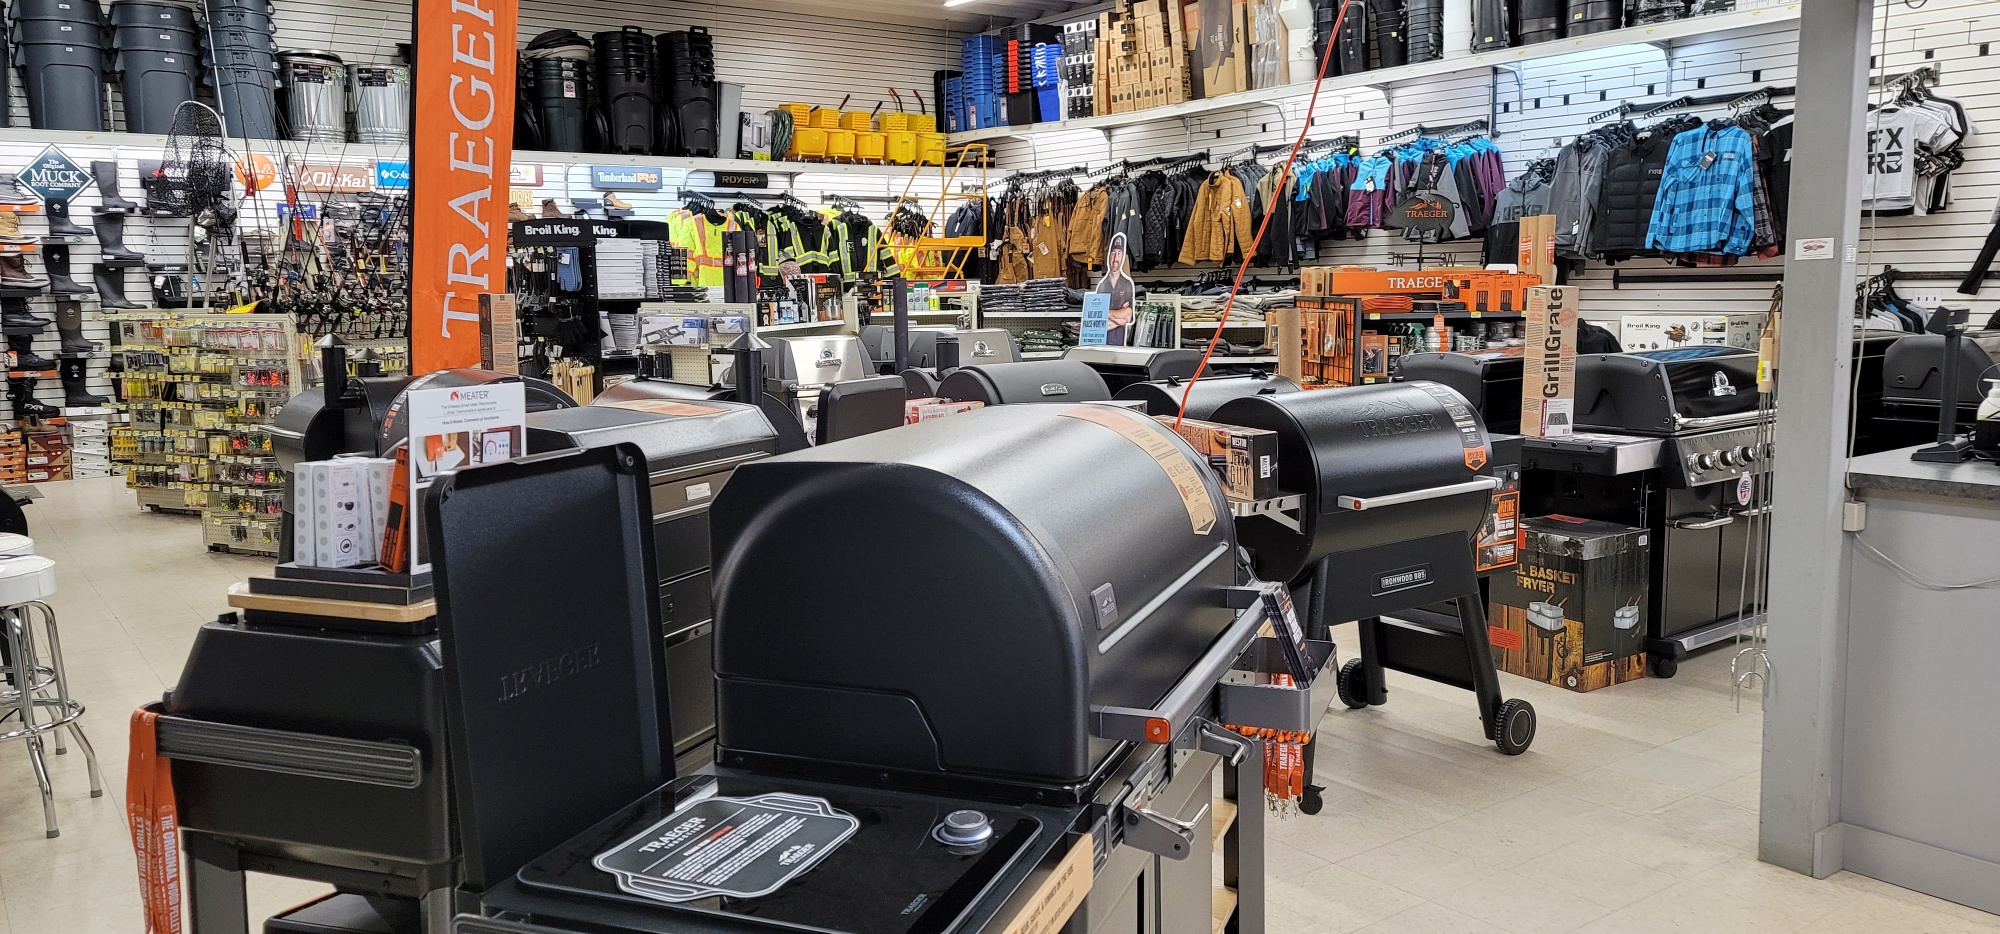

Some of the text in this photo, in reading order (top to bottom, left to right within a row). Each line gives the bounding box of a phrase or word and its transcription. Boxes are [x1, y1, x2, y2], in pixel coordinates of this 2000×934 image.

[30, 168, 82, 182] MUCK
[313, 171, 367, 188] OluKai
[597, 171, 637, 183] Timberland
[722, 175, 756, 185] ROYER
[1405, 210, 1448, 218] TRAEGER
[524, 224, 617, 237] Broil King King
[1387, 276, 1443, 289] TRAEGE
[1644, 322, 1661, 330] King
[1542, 287, 1563, 398] GrillGrate
[460, 390, 489, 401] MEATER
[24, 403, 44, 411] FXR
[1352, 413, 1441, 438] TRAEGER
[1230, 465, 1249, 486] GUN
[1382, 573, 1413, 587] IRONWOOD
[1529, 564, 1579, 585] BASKET
[1516, 575, 1556, 593] FRYER
[1280, 743, 1288, 770] TRAEGE
[136, 816, 144, 849] GRILLS
[638, 816, 707, 853] TRAEGER
[138, 851, 147, 878] FIRED
[161, 814, 181, 933] THE ORIGINAL WOOD PELLET
